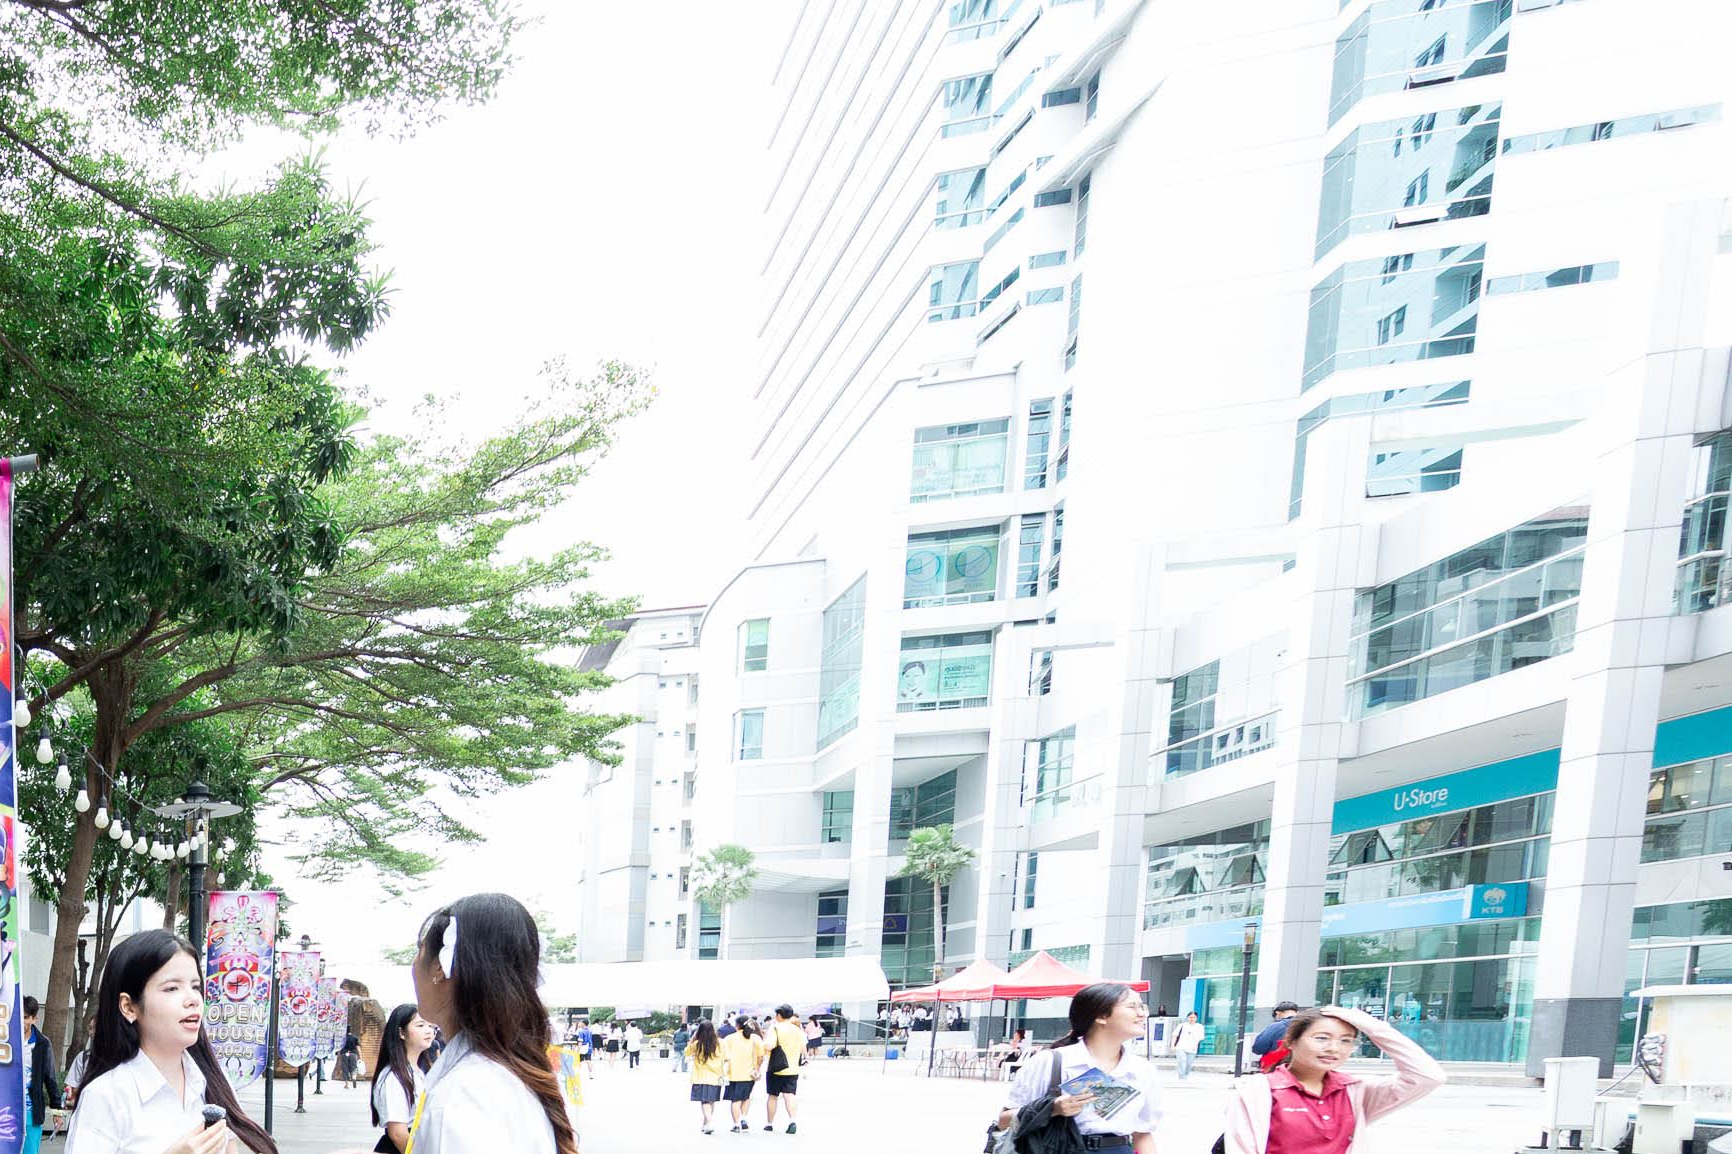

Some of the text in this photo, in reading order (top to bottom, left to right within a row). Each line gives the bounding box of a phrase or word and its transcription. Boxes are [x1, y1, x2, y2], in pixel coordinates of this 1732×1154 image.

[206, 1003, 265, 1026] OPEN
[281, 1015, 315, 1029] OPEN
[206, 1025, 266, 1044] HOUSE
[214, 1043, 254, 1060] 2025
